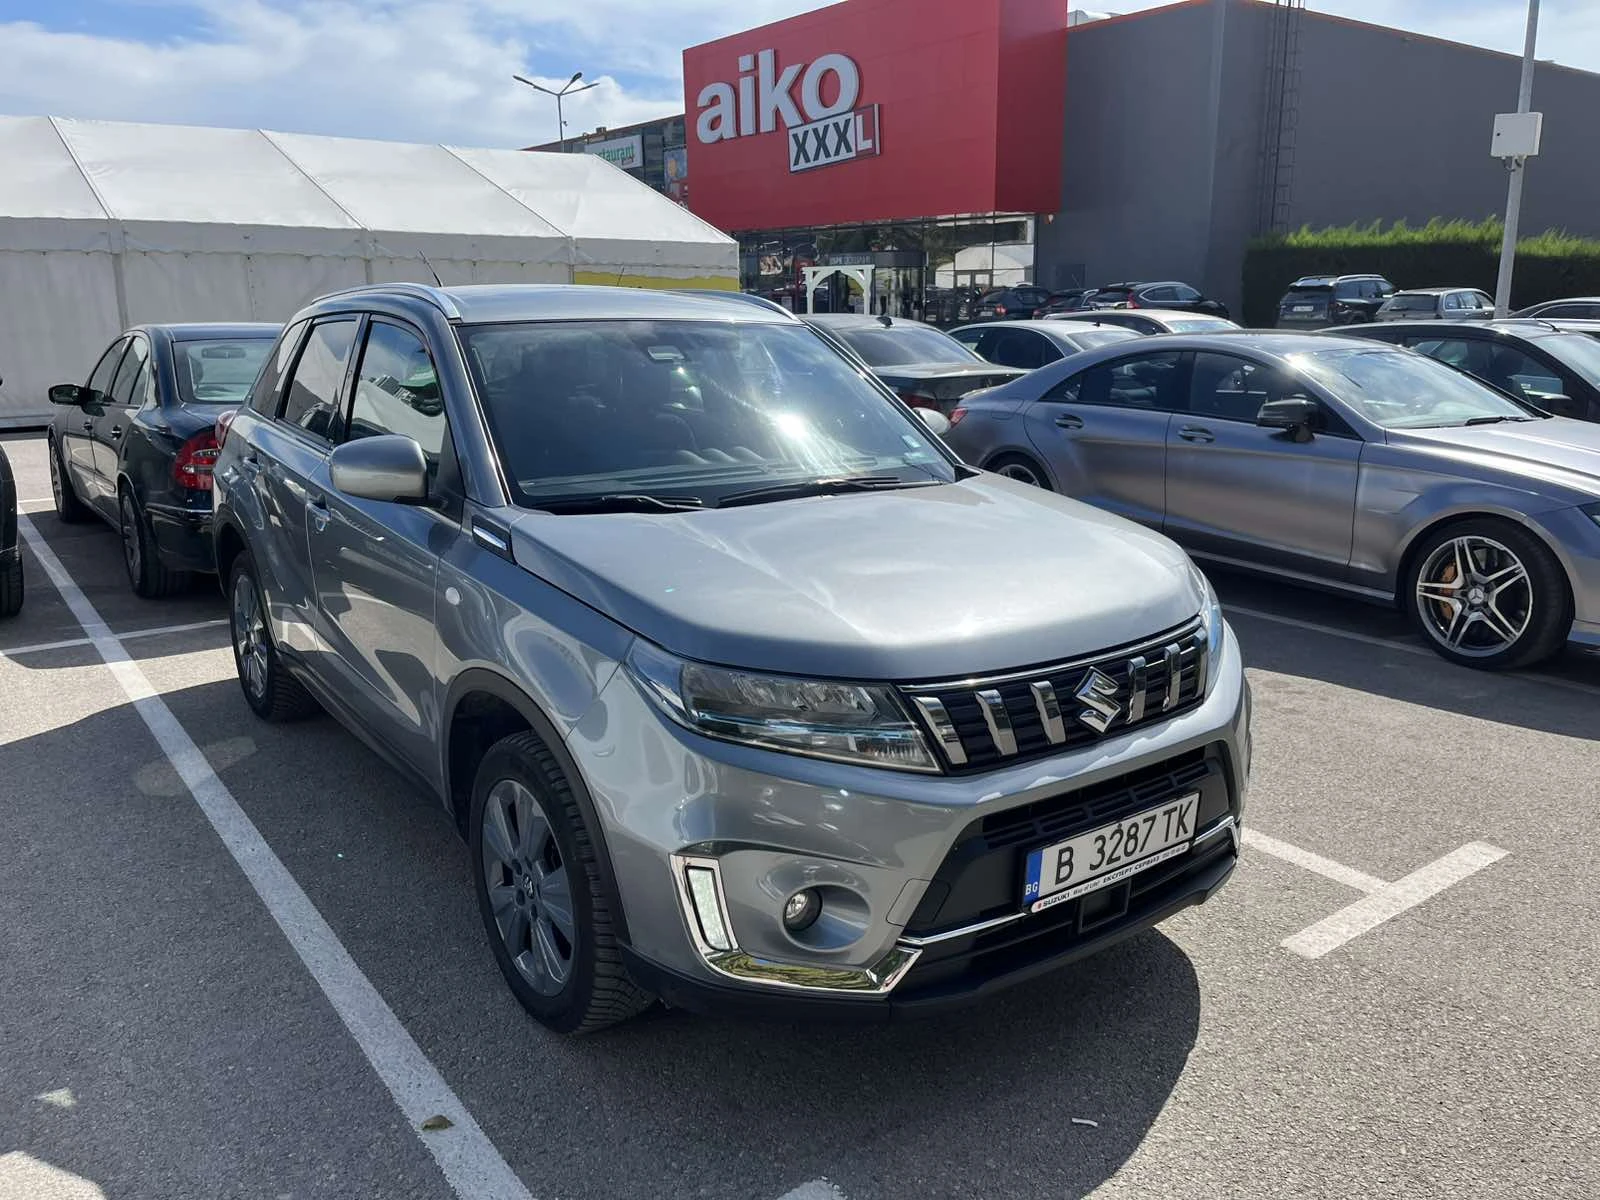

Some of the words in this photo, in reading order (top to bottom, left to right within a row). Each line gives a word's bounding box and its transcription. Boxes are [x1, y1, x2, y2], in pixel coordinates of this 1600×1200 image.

[697, 48, 859, 144] aiko
[598, 144, 634, 162] staurant
[1055, 846, 1074, 885] B
[1089, 816, 1157, 871] 3287
[1163, 800, 1193, 842] TK
[1025, 882, 1038, 895] BG
[1043, 892, 1070, 907] SUZUKI
